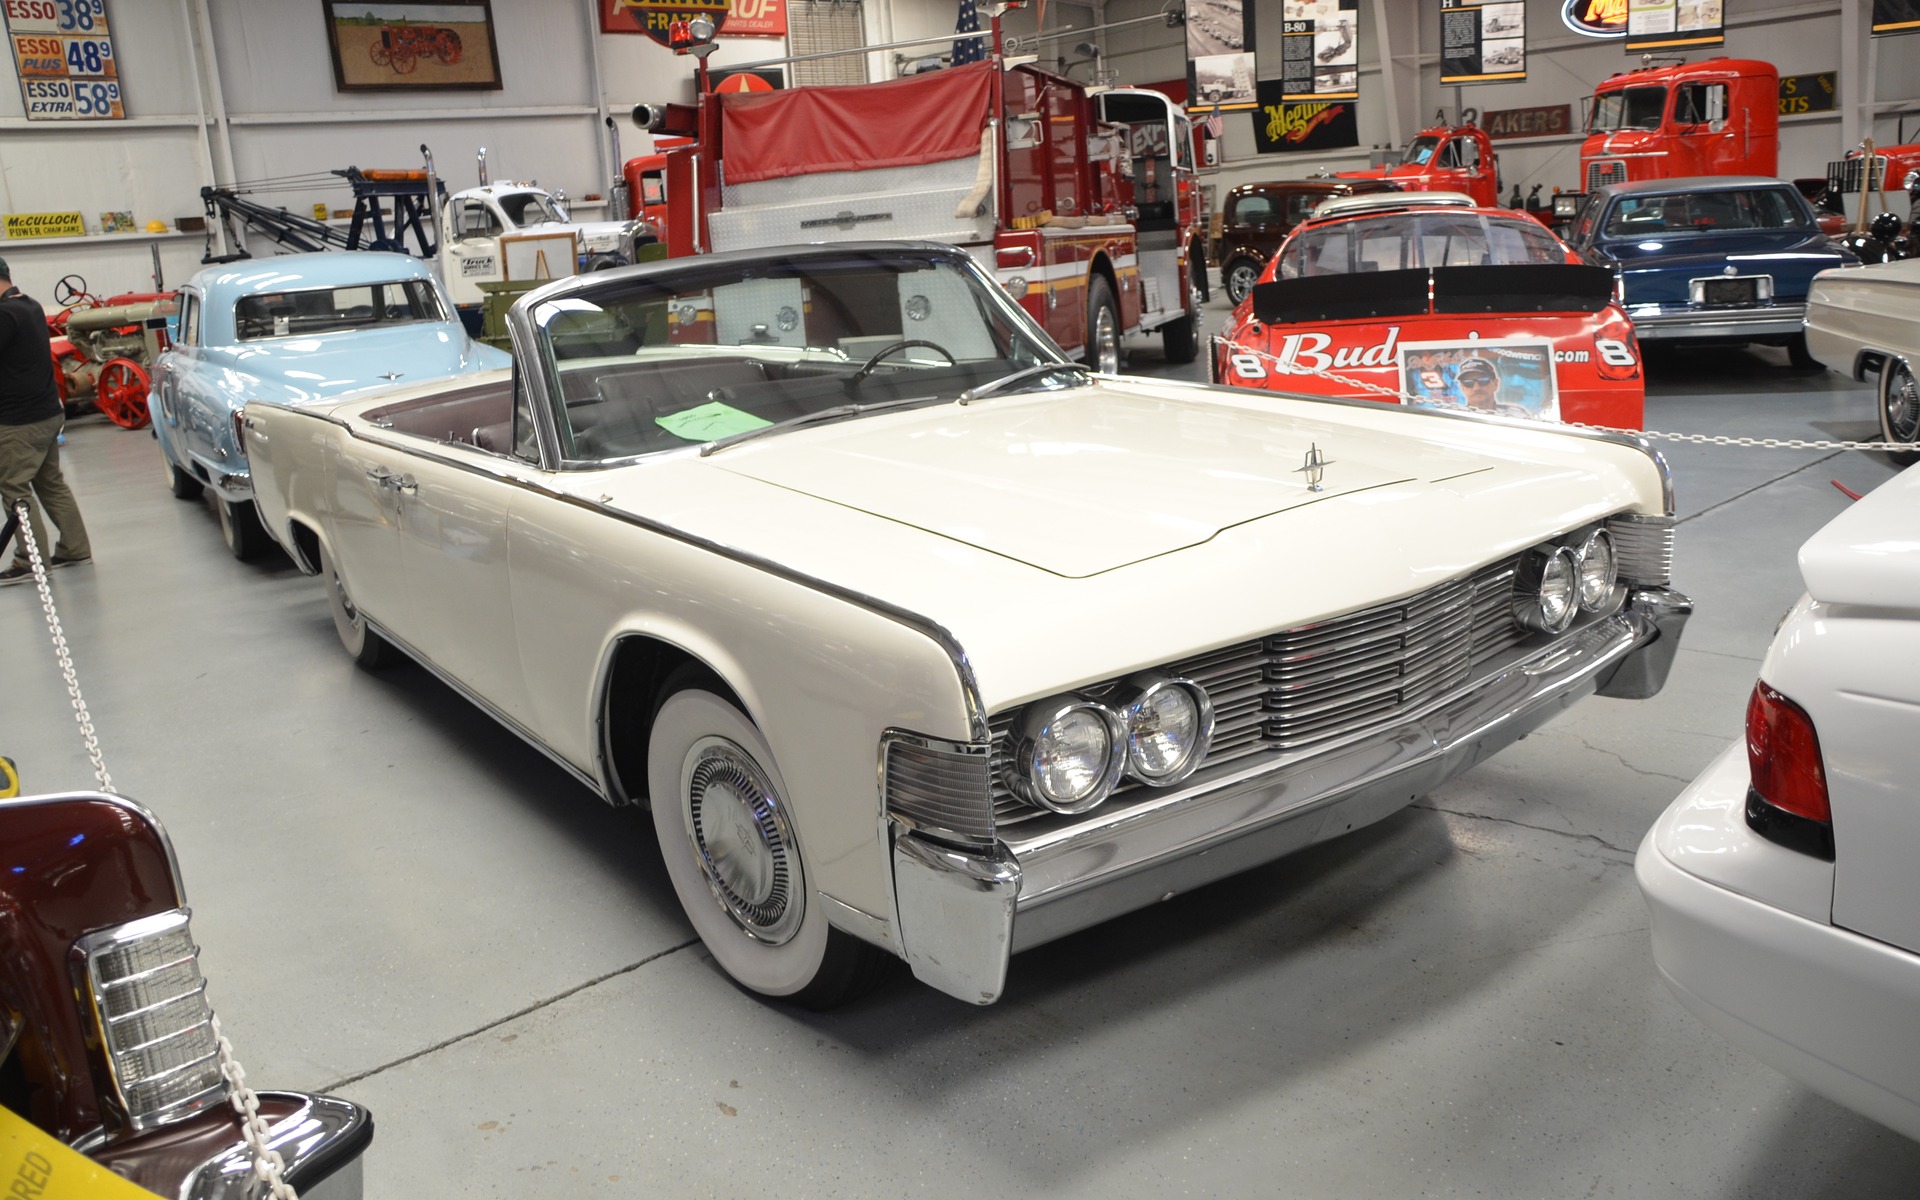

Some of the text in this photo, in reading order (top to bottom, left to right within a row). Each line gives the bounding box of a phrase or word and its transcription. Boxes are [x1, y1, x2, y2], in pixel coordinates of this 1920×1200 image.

[5, 0, 56, 19] ESSO
[1284, 22, 1306, 32] B-80
[17, 39, 60, 55] ESSO
[23, 58, 62, 69] PLUS
[26, 82, 69, 98] ESSO
[31, 102, 73, 112] EXTRA
[1435, 109, 1444, 119] A
[1490, 109, 1562, 135] AKERS
[8, 214, 79, 227] McCULLOCH
[9, 226, 42, 237] POWER
[1596, 339, 1637, 367] 8
[1231, 354, 1267, 379] 8
[1420, 370, 1446, 390] 3
